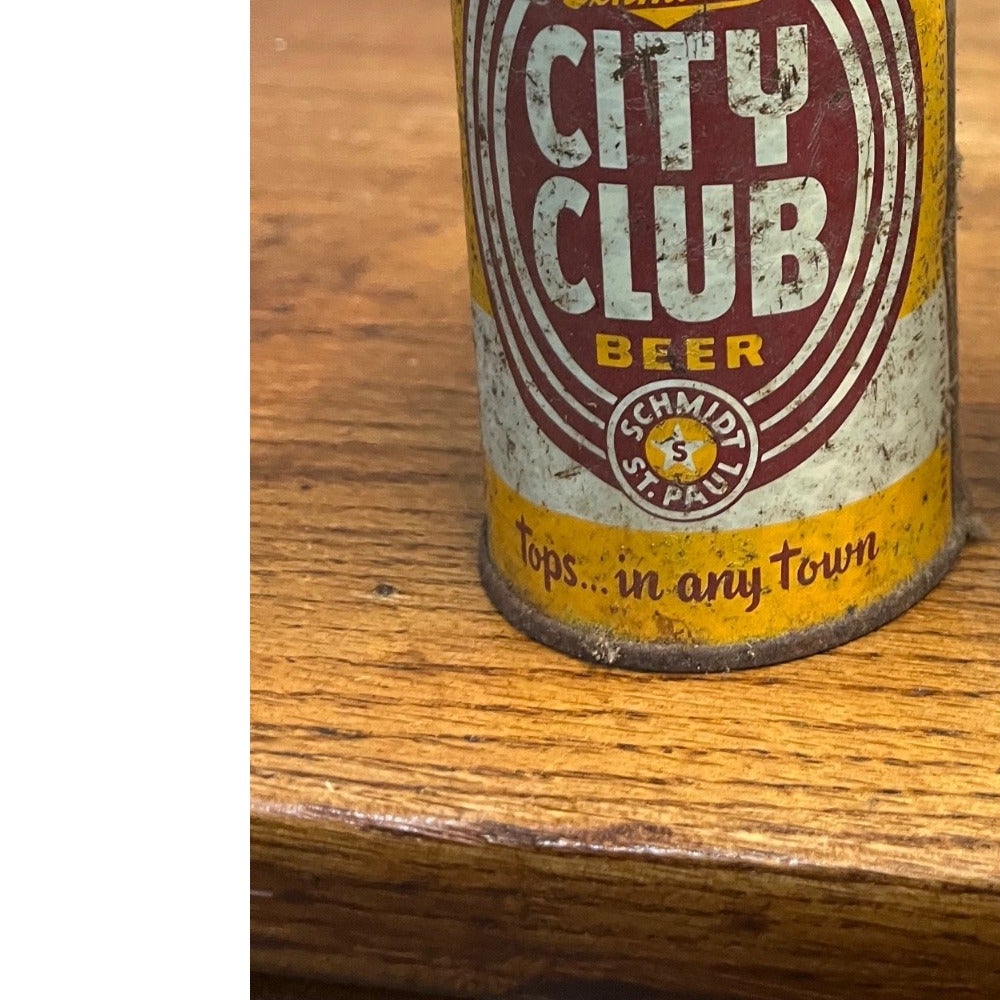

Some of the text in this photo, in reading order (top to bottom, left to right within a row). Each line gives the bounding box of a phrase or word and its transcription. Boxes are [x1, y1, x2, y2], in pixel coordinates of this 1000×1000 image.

[525, 24, 809, 170] CITY
[532, 176, 829, 323] CLUB
[595, 333, 764, 371] BEER
[621, 391, 746, 448] SCHMIDT
[671, 440, 688, 462] S
[663, 462, 743, 506] PAUL
[614, 553, 664, 601] in
[677, 566, 761, 613] any
[769, 531, 880, 590] town
